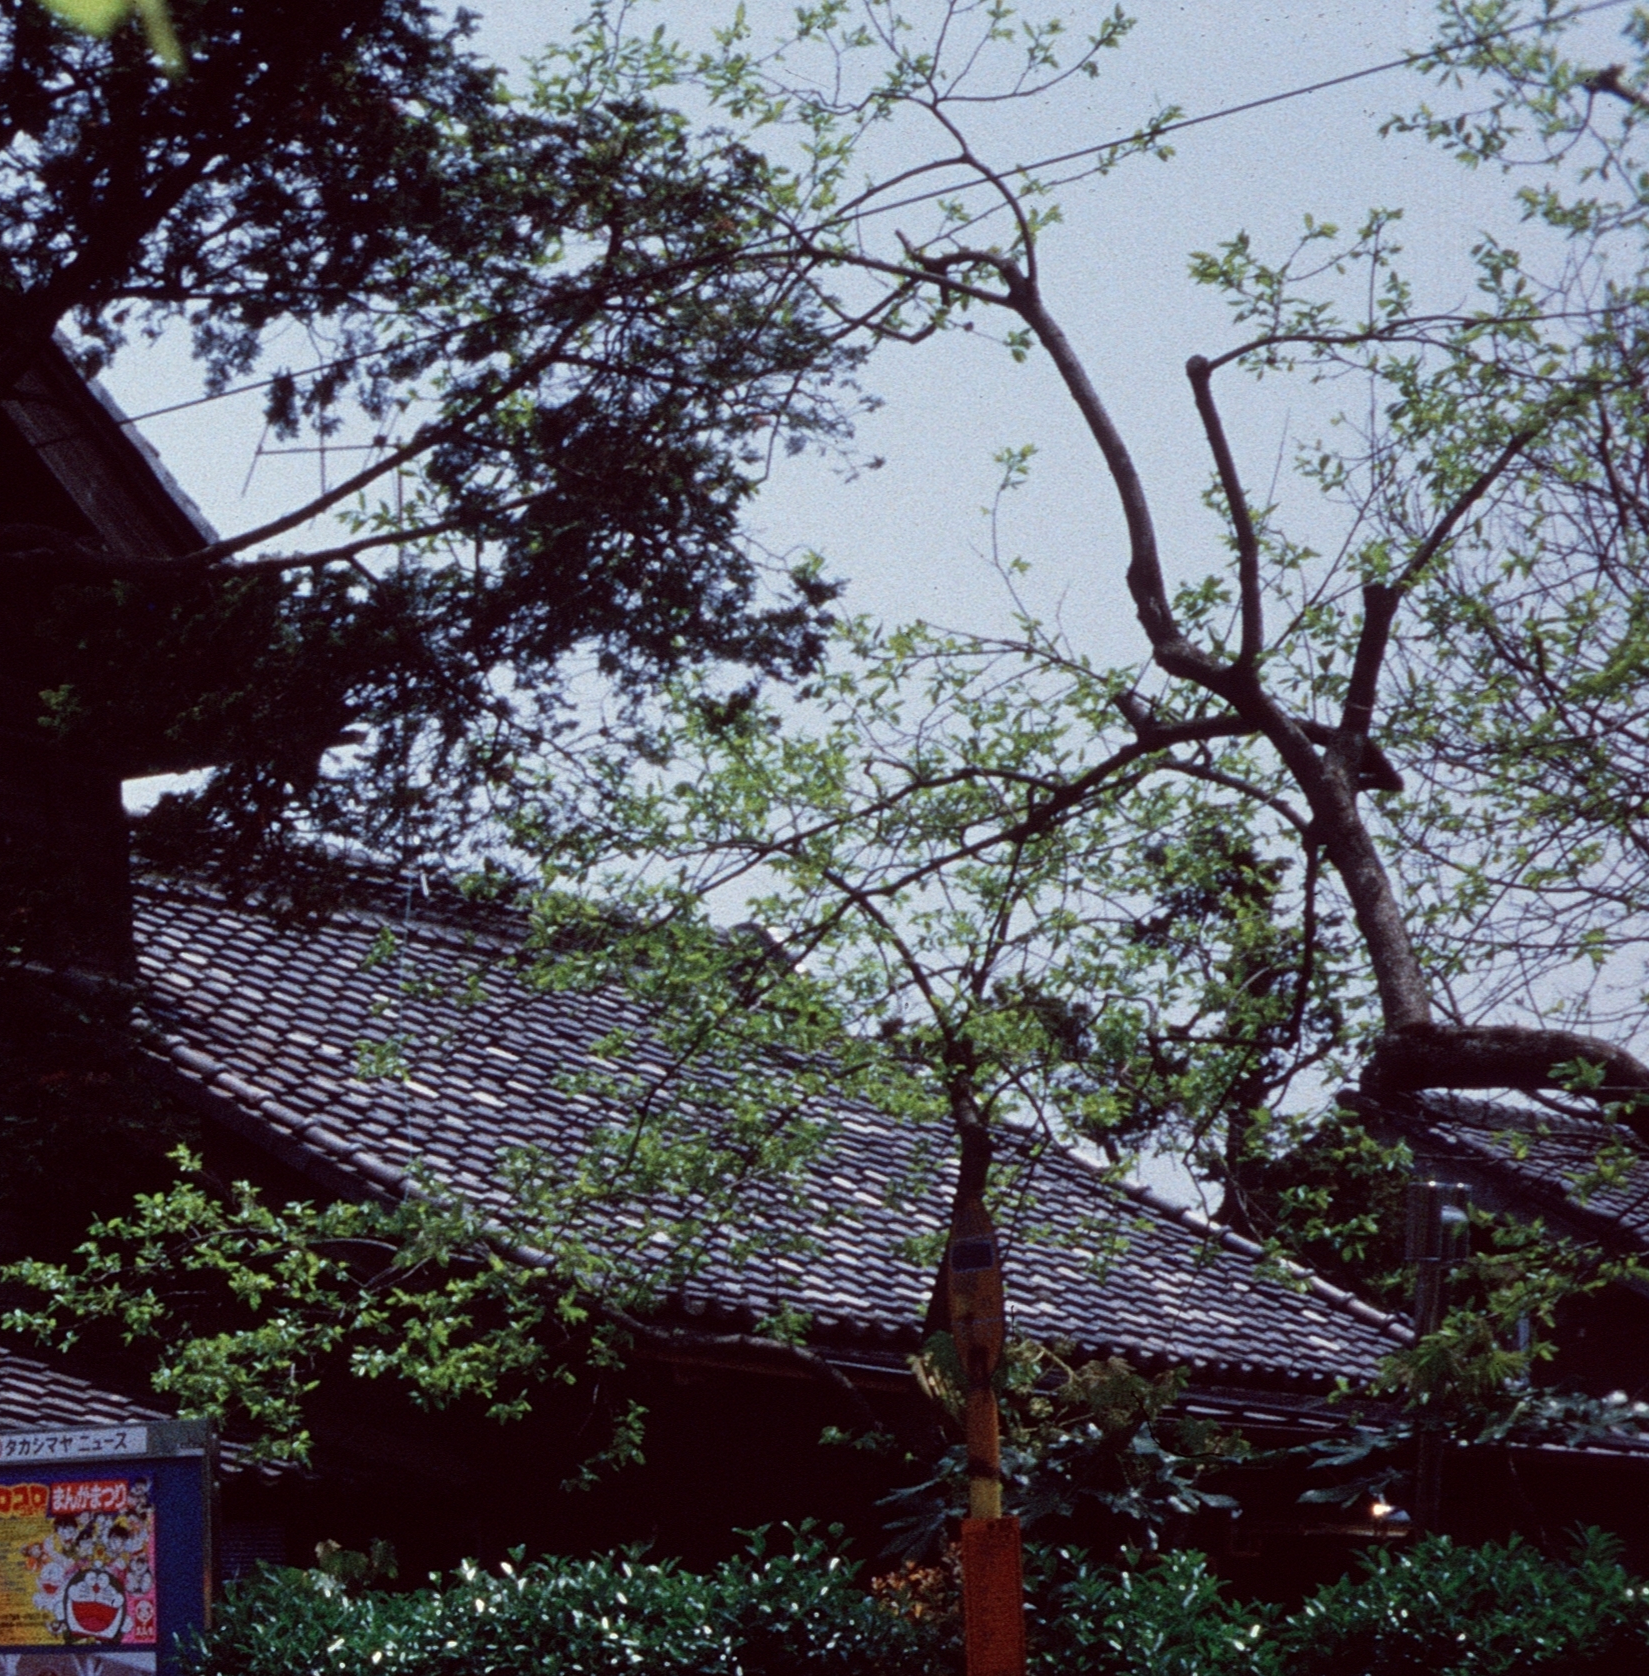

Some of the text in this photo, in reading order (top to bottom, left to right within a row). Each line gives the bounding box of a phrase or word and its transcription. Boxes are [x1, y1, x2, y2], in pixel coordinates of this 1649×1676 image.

[5, 1434, 73, 1457] タカシマヤ
[78, 1431, 127, 1452] ニュース
